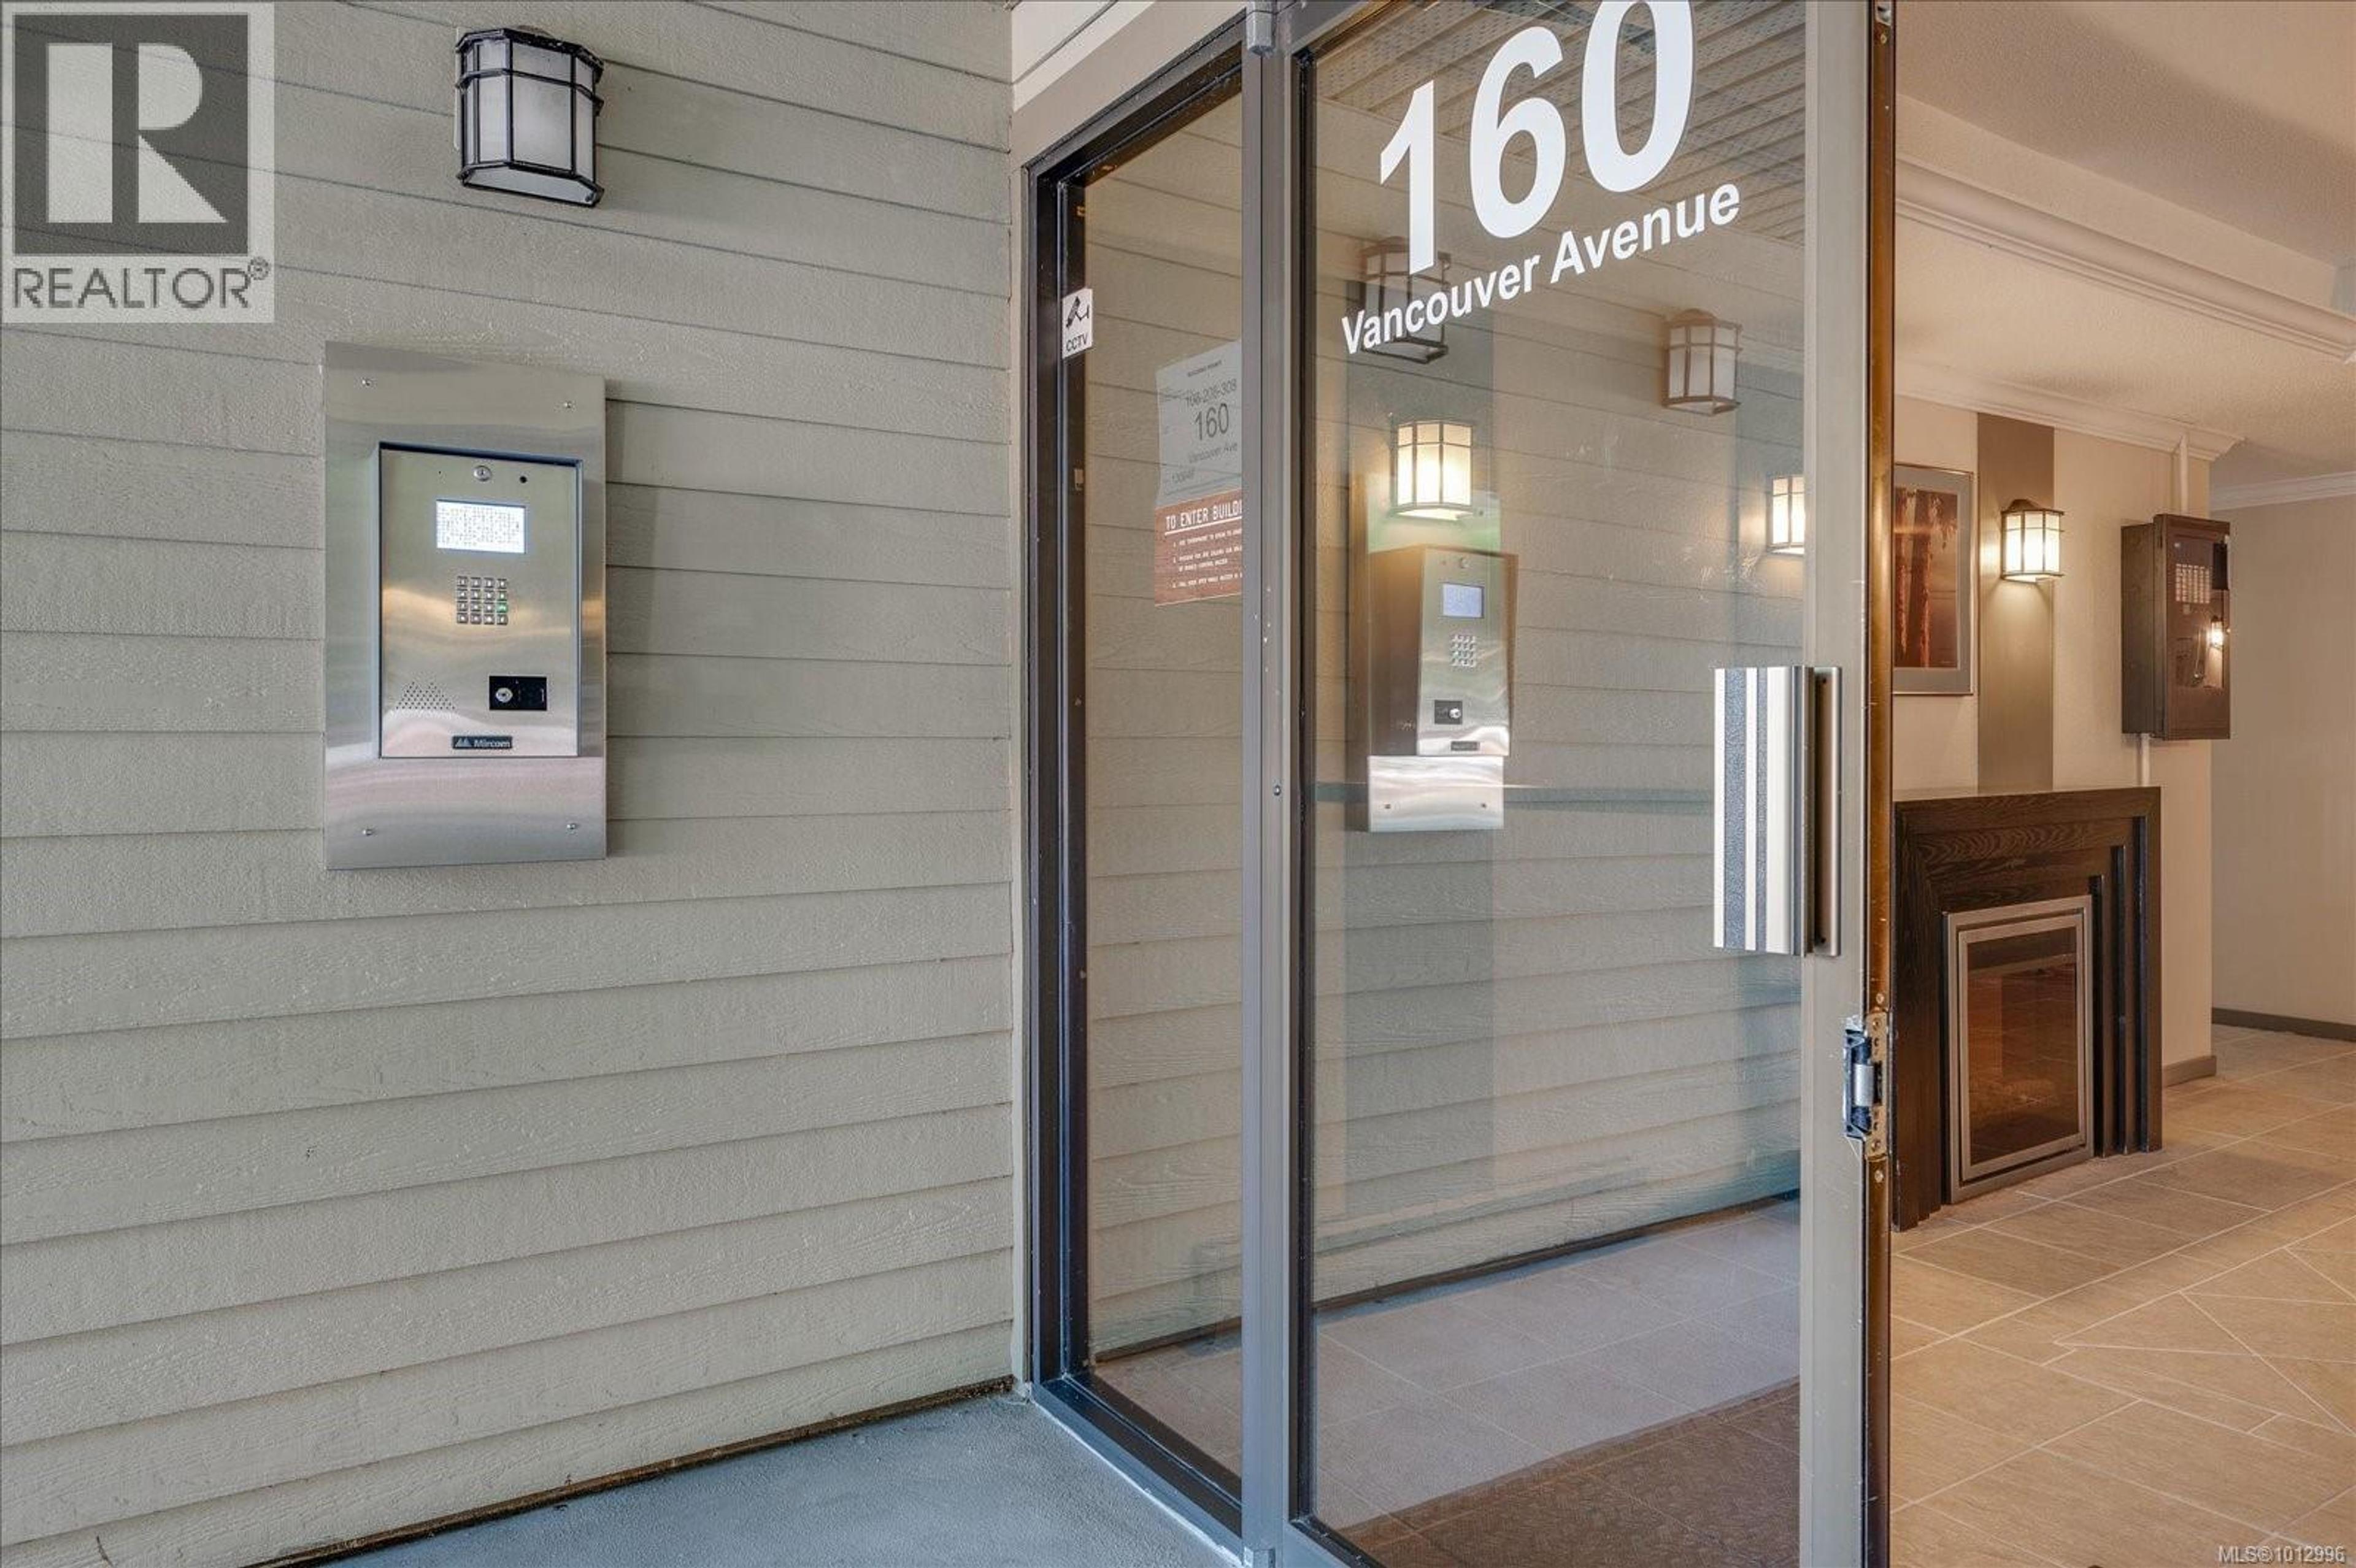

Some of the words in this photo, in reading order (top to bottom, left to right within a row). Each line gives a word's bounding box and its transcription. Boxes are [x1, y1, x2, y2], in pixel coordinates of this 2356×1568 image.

[1381, 0, 1693, 275] 160
[1341, 255, 1541, 355] Vancouver
[1550, 183, 1741, 284] Avenue
[1066, 333, 1088, 352] CCTV
[1195, 403, 1230, 440] 160
[1166, 515, 1176, 531] TO
[1180, 508, 1209, 527] ENTER
